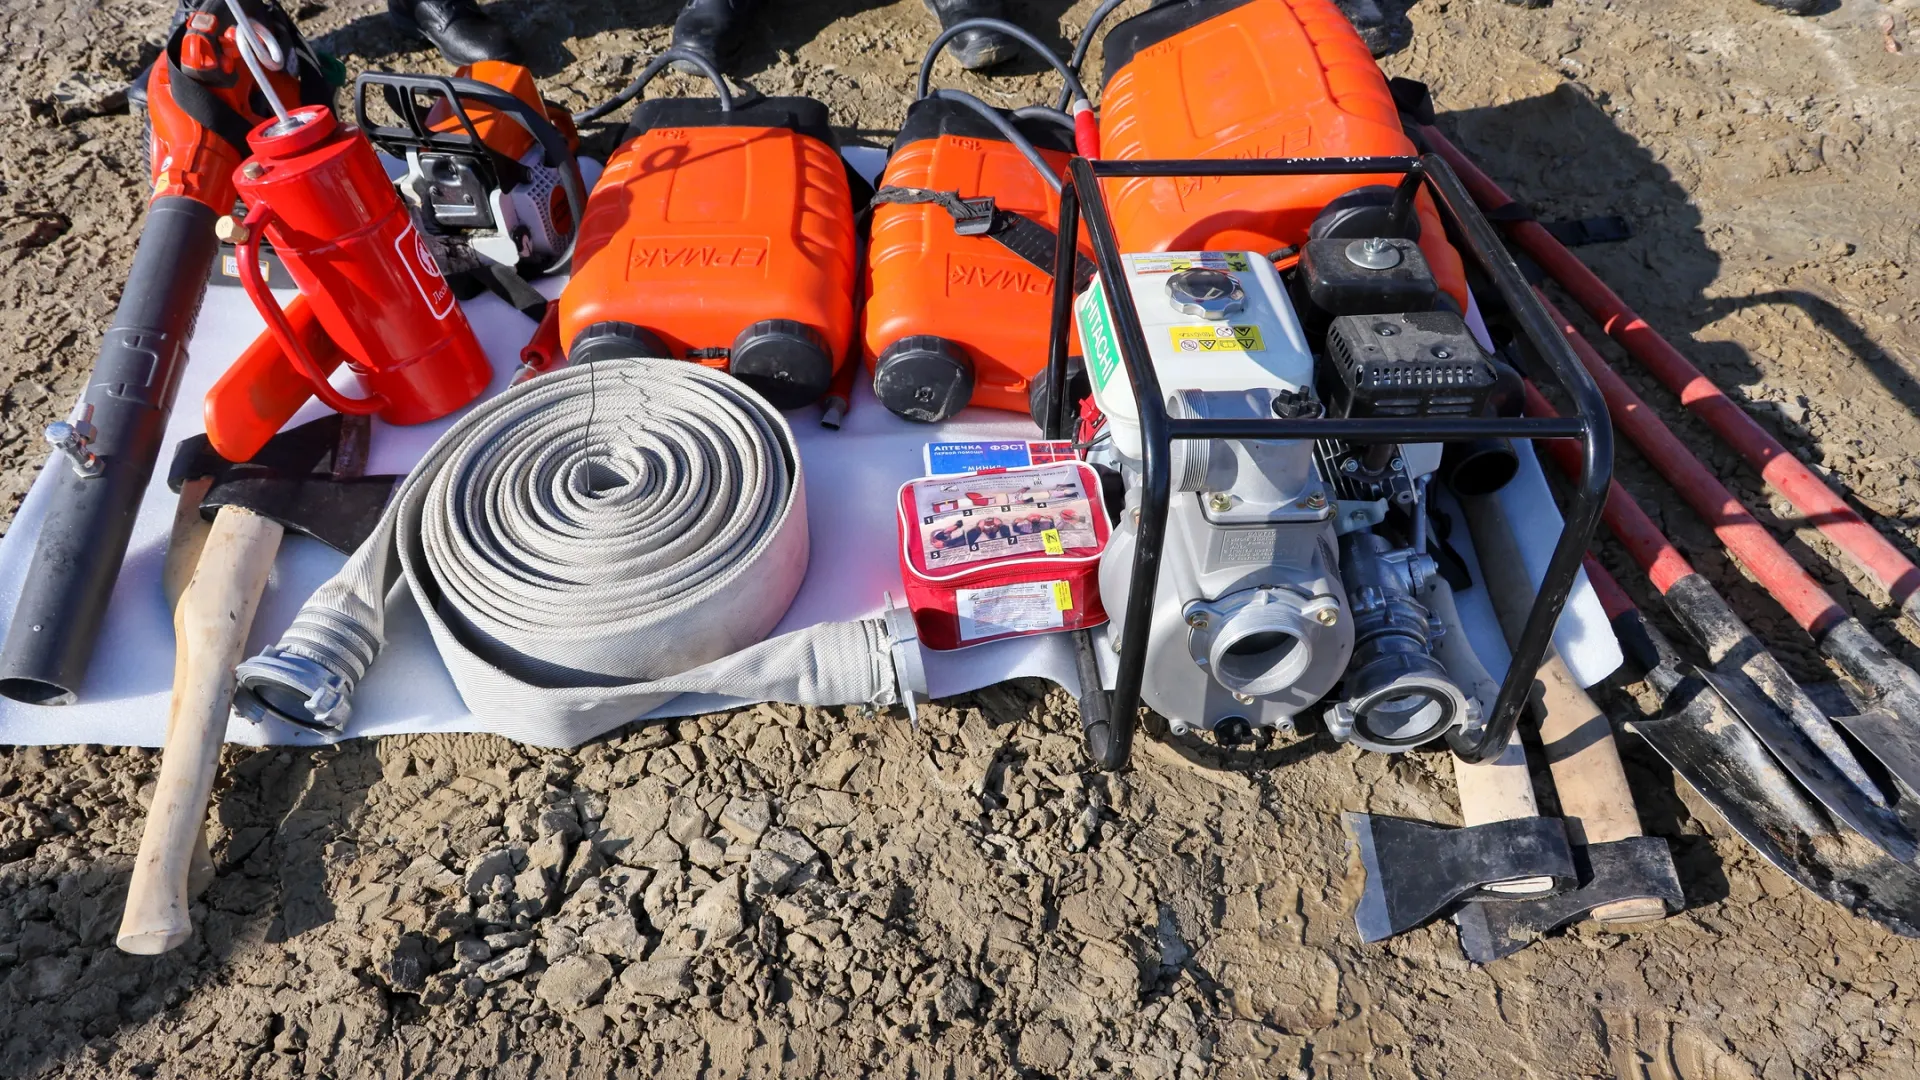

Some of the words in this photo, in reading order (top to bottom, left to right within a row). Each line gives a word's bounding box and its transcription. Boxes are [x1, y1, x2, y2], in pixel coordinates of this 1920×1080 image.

[633, 247, 768, 269] ЕРМАК
[949, 264, 1054, 297] РМАК
[1085, 291, 1114, 382] HITACHI
[933, 444, 982, 452] АПТЕЧКА
